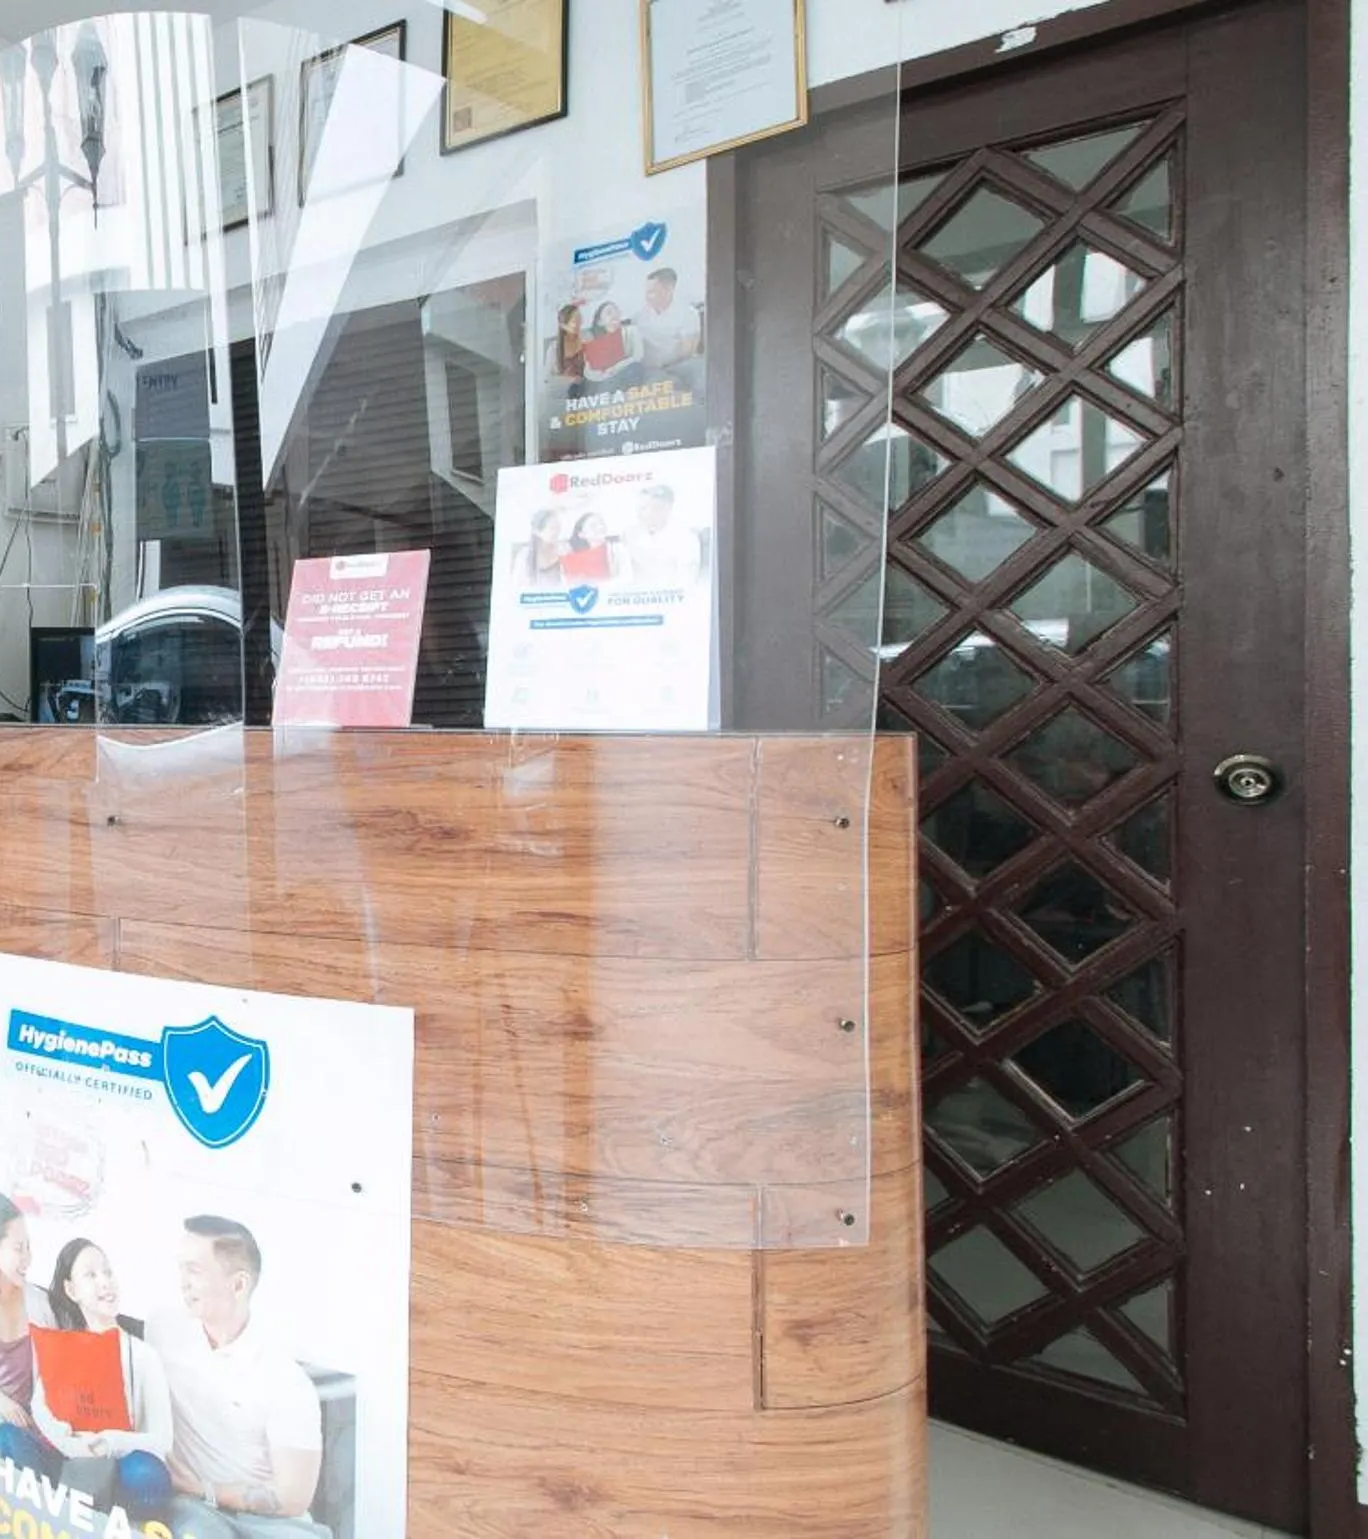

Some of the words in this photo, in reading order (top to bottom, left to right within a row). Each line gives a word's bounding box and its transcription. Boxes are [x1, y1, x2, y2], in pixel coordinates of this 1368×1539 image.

[549, 416, 562, 430] &
[564, 391, 693, 427] COMFORTABLE
[565, 391, 610, 412] HAVE
[611, 389, 625, 404] A
[627, 380, 674, 400] SAFE
[597, 416, 641, 436] STAY
[569, 472, 653, 489] RedDoorz
[301, 593, 326, 605] DID
[327, 591, 357, 603] NOT
[359, 589, 385, 601] GET
[389, 588, 411, 600] AN
[311, 633, 389, 650] REFUND!
[18, 1023, 153, 1068] HygienePass
[14, 1061, 82, 1084] OFFICIALLY
[84, 1077, 153, 1101] CERTIFIED
[103, 1505, 133, 1539] A
